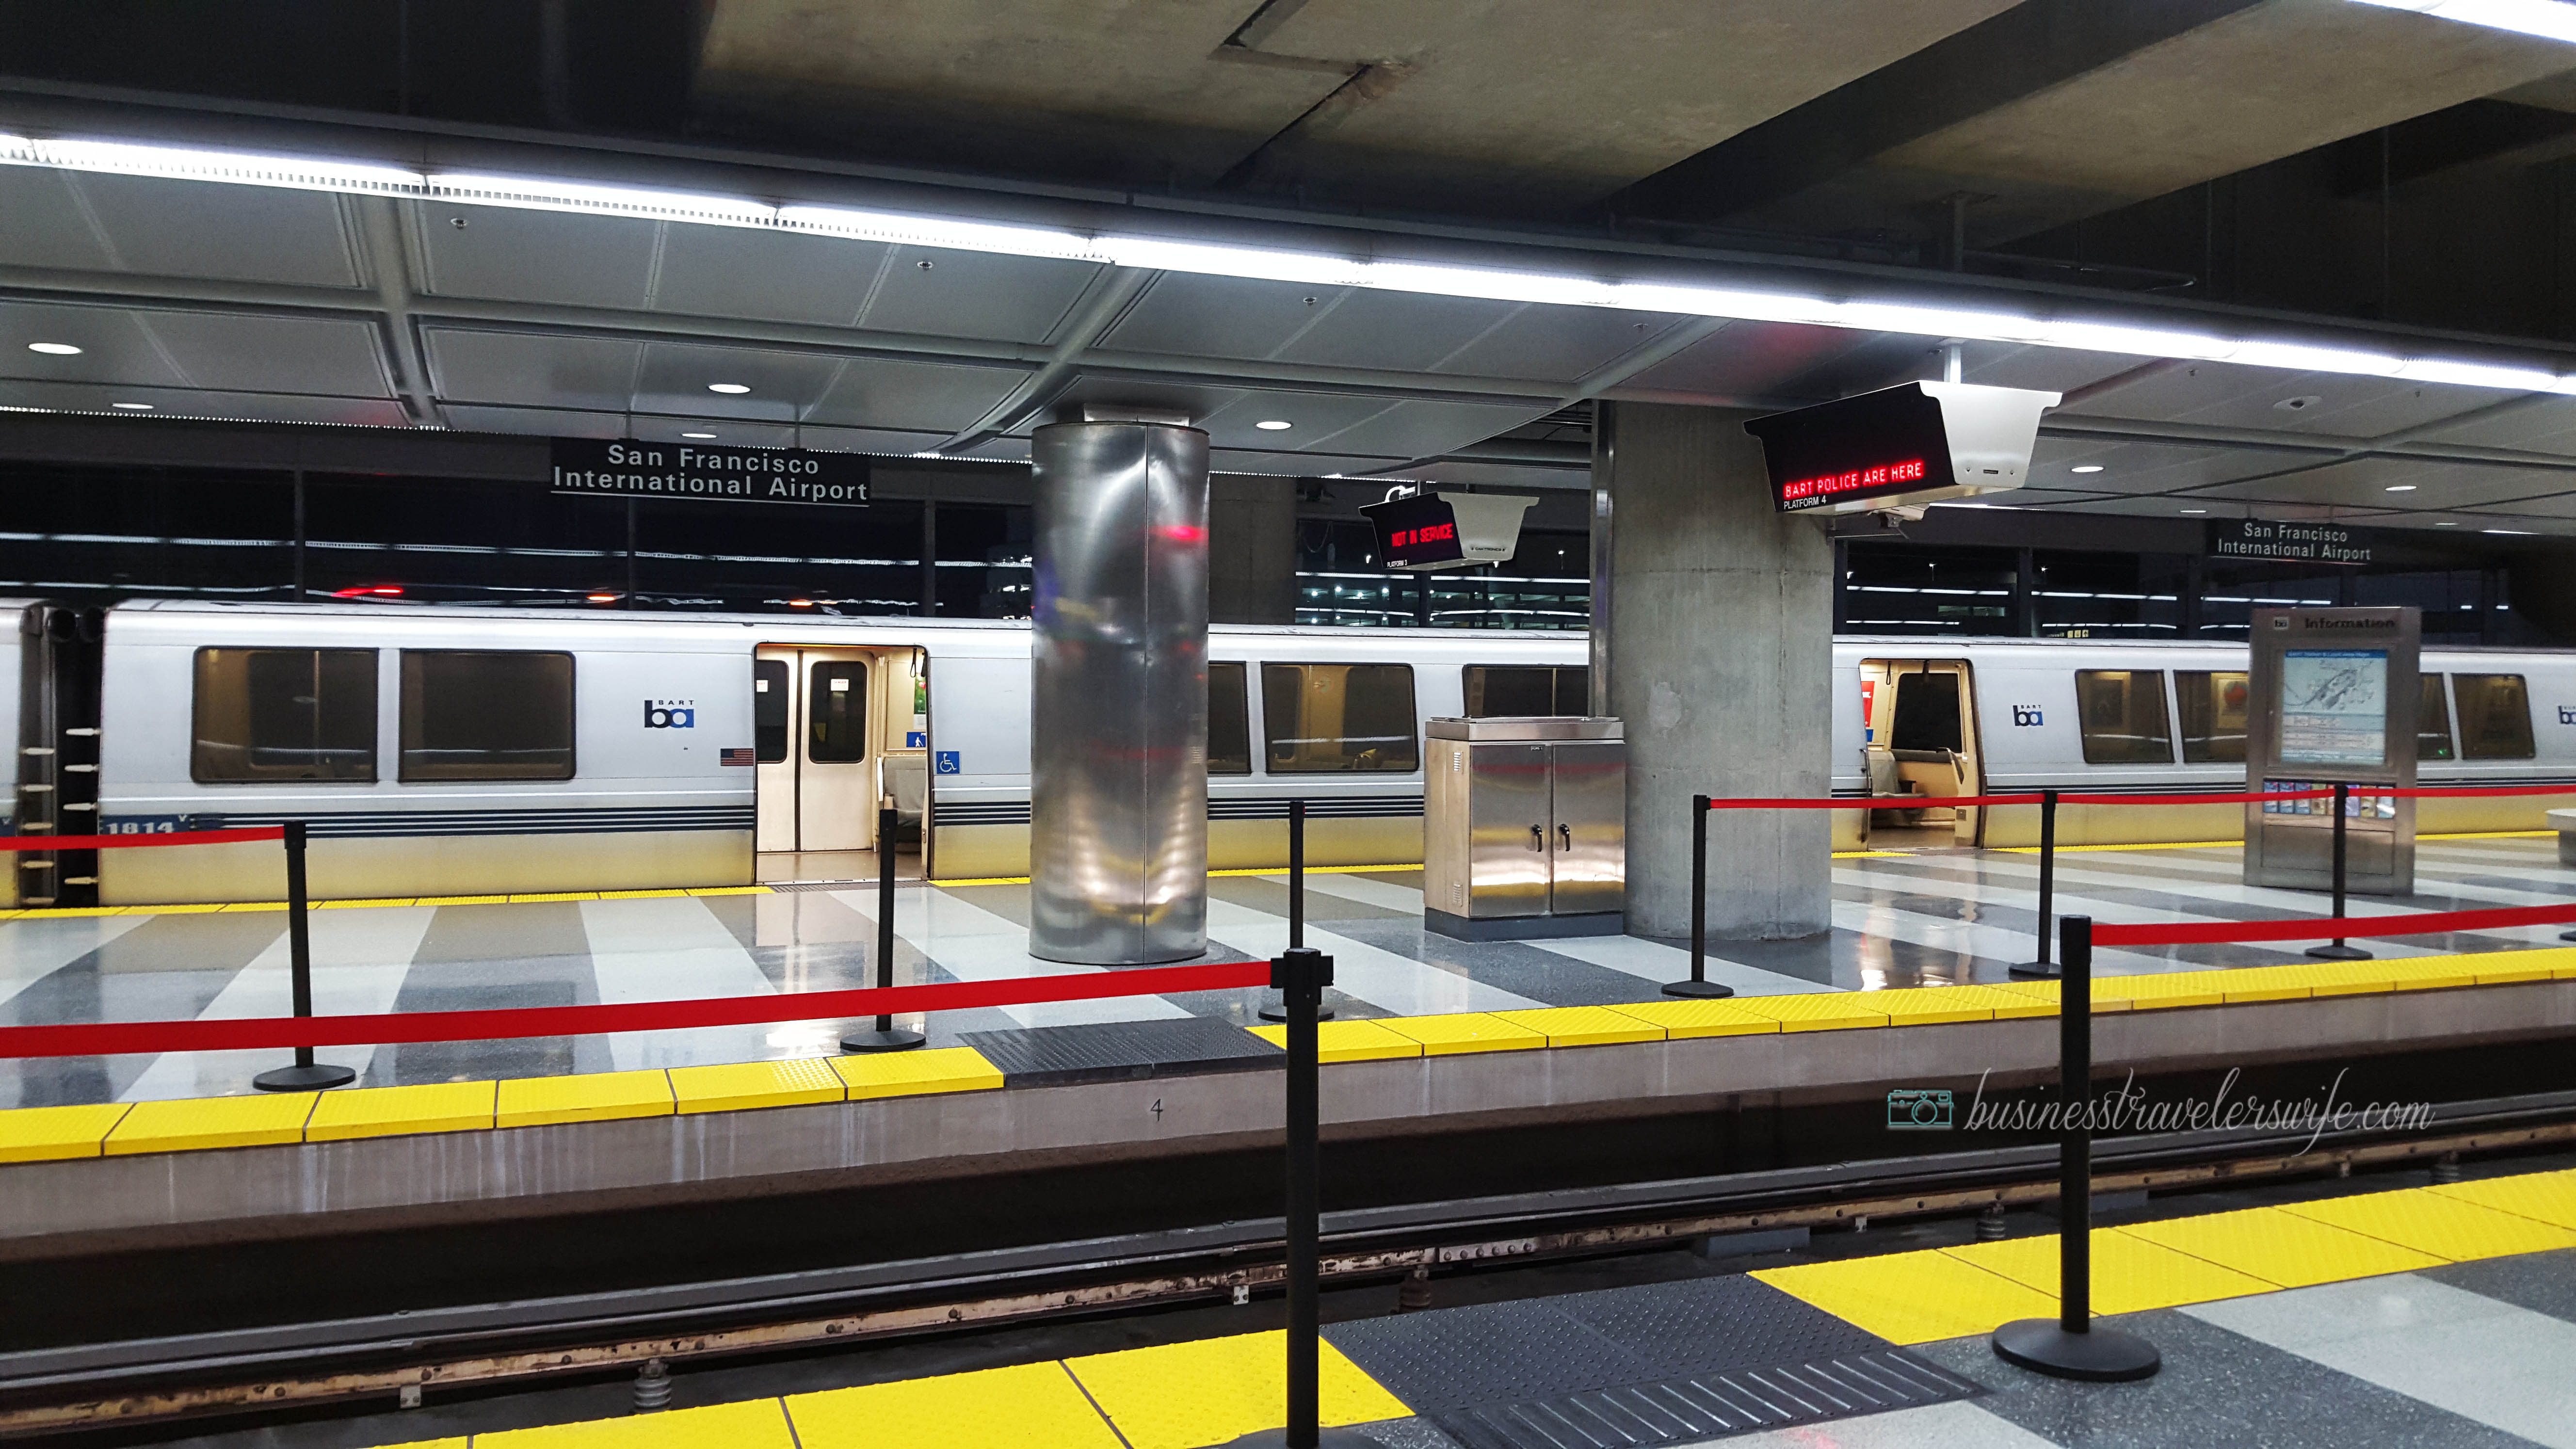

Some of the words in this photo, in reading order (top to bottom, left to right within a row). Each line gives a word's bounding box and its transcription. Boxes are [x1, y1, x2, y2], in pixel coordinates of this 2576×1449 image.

[608, 444, 663, 466] San
[680, 448, 819, 474] Francisco
[554, 466, 751, 495] International
[768, 476, 867, 501] Airport
[1785, 481, 1813, 498] BART
[1818, 473, 1858, 492] POLICE
[1863, 468, 1886, 485] ARE
[1891, 462, 1922, 480] HERE
[1784, 496, 1819, 509] PLATFORM
[1821, 495, 1827, 504] 4
[1391, 531, 1406, 547] NOT
[1409, 530, 1417, 545] IN
[1420, 523, 1453, 543] SERVICE
[2244, 522, 2271, 538] San
[2279, 525, 2348, 542] Francisco
[2218, 538, 2314, 557] International
[2321, 546, 2371, 562] Airport
[1387, 560, 1404, 568] PLATFORM
[2305, 617, 2396, 629] Information
[106, 821, 175, 835] 1814
[1150, 1098, 1163, 1122] 4
